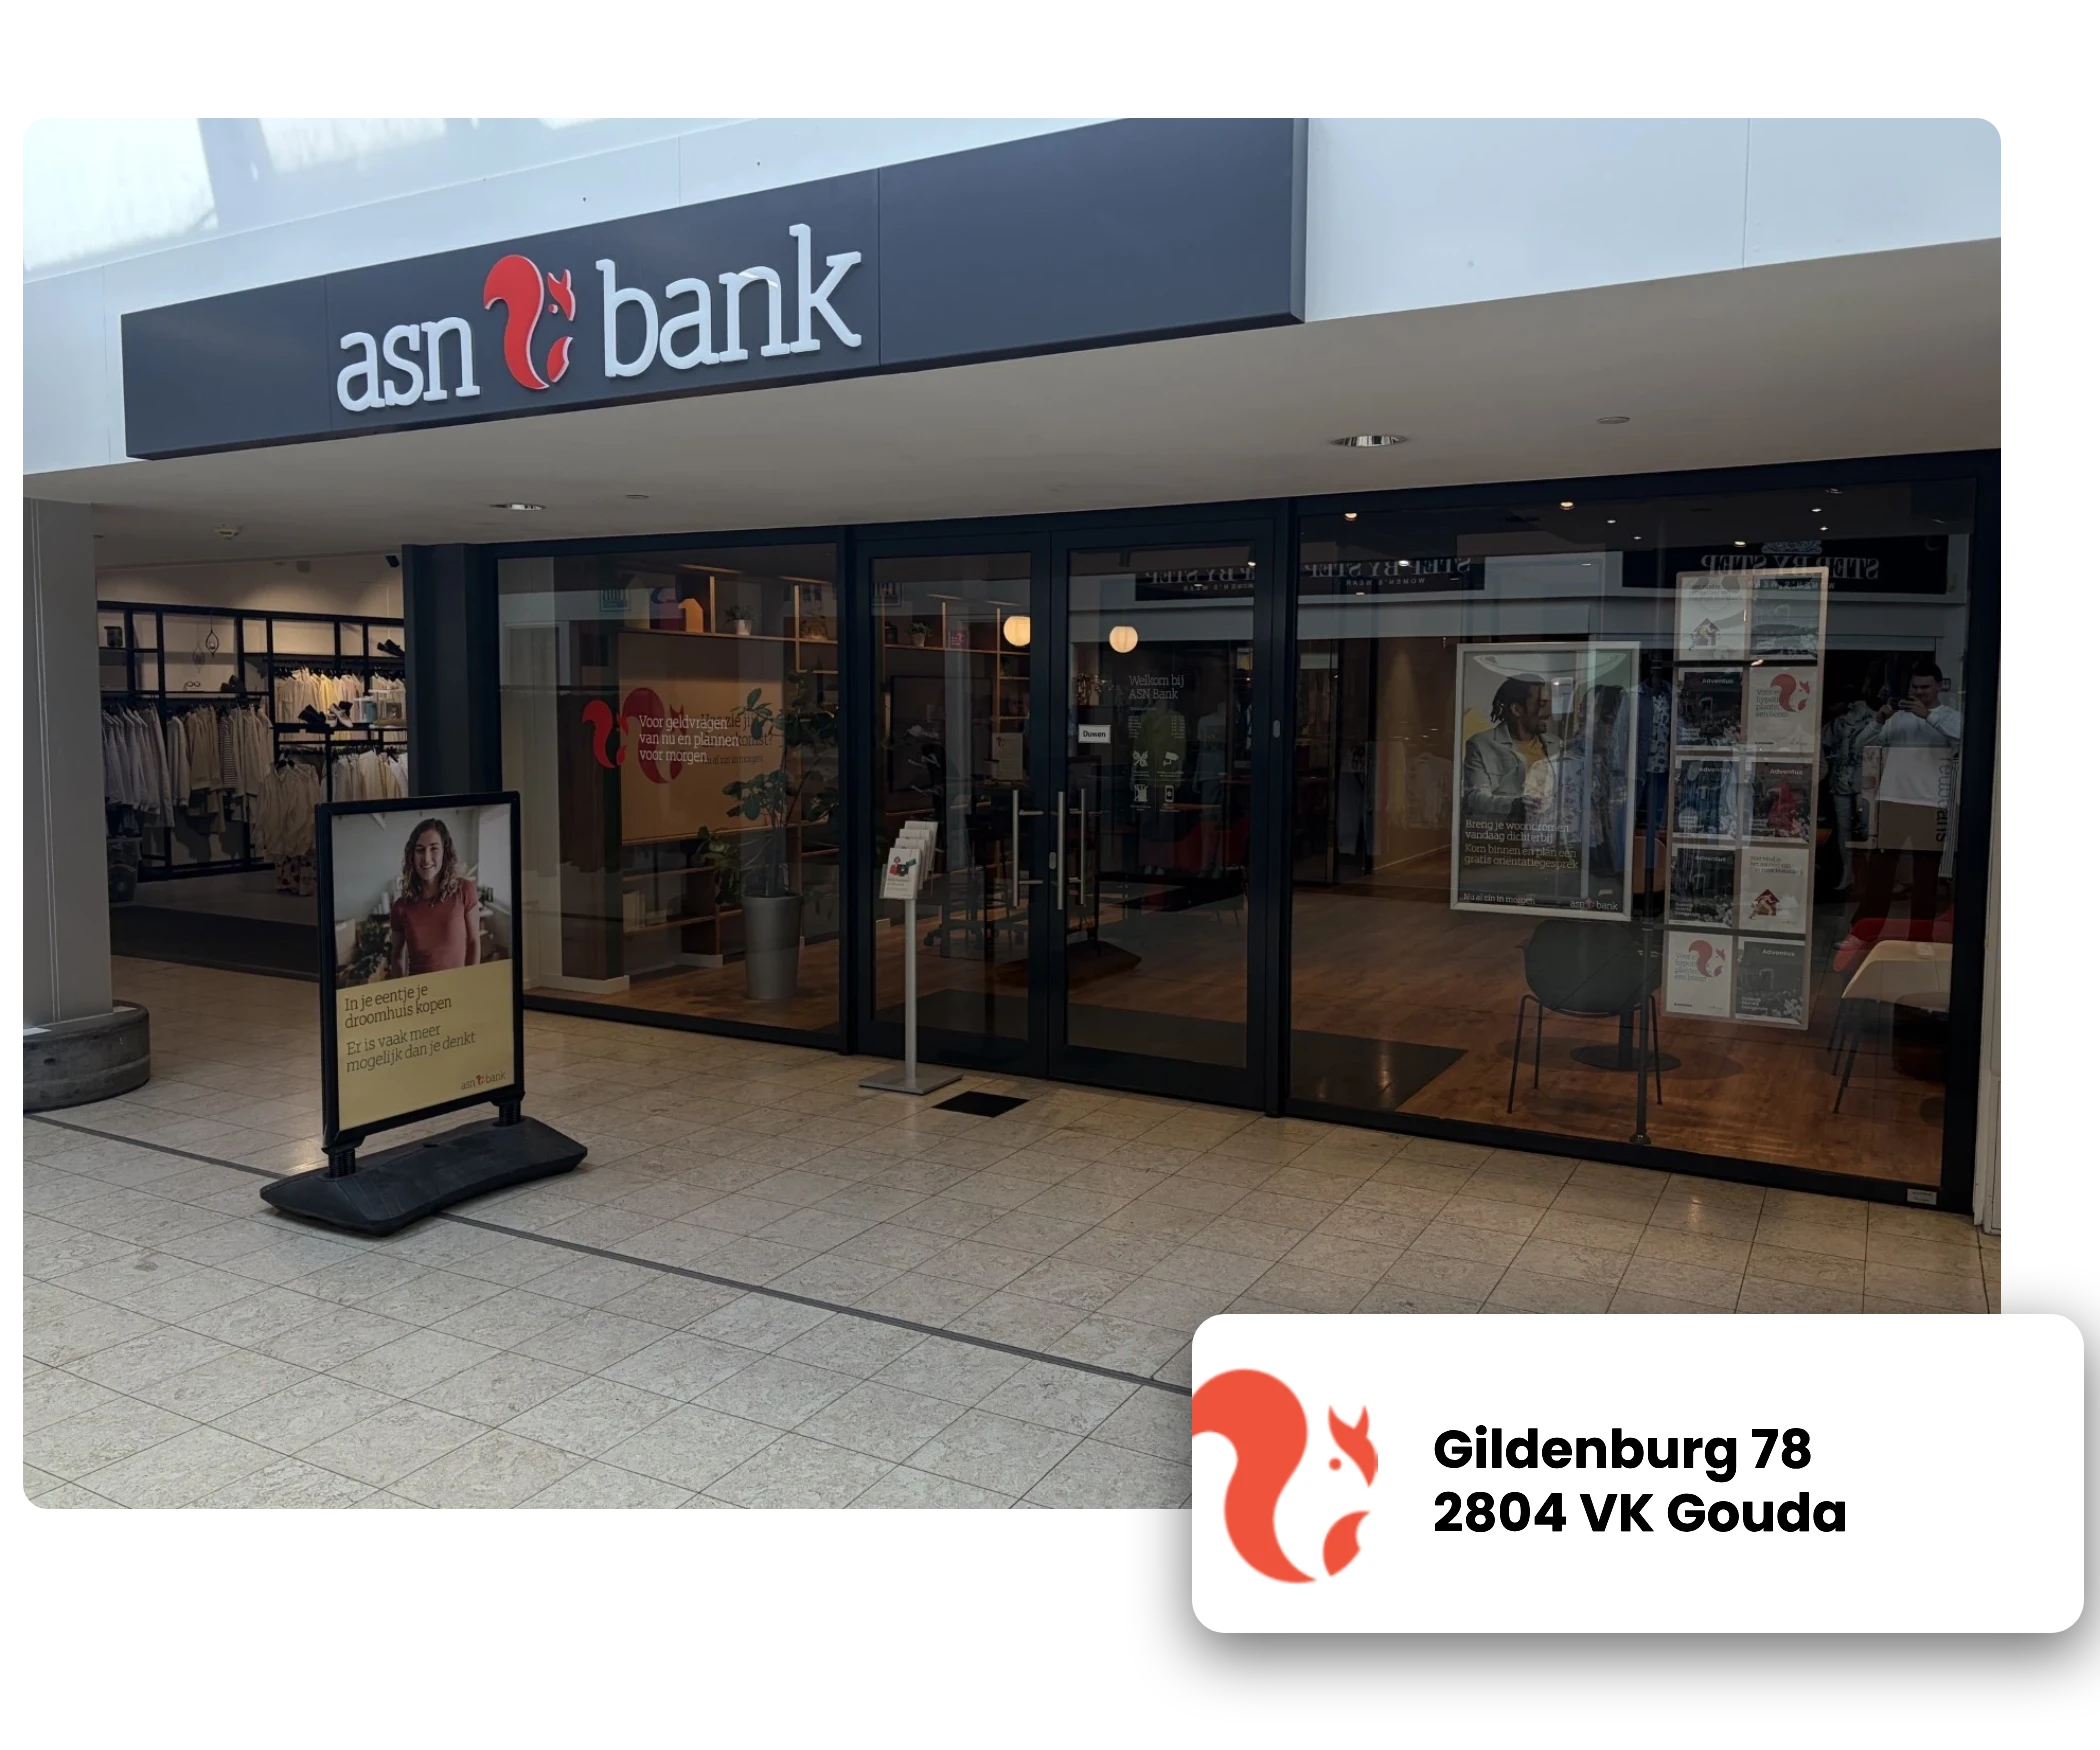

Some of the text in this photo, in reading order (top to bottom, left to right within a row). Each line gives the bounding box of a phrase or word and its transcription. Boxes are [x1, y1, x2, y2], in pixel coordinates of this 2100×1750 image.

[336, 223, 863, 413] asn bank
[1128, 674, 1184, 688] Welkom bij
[1128, 688, 1179, 700] ASN Bank
[639, 714, 663, 728] Voor
[666, 715, 728, 732] geldvragen
[639, 733, 659, 745] van
[662, 734, 675, 745] nu
[678, 734, 691, 745] en
[694, 732, 740, 748] plannen
[1083, 730, 1106, 738] Duwen
[639, 750, 707, 764] voor morgen
[1770, 768, 1803, 776] Adventus
[1465, 819, 1494, 832] Breng
[1495, 820, 1504, 831] je
[1465, 830, 1505, 843] vandaag
[1464, 844, 1487, 853] Kom
[1488, 844, 1520, 855] binnen
[1464, 855, 1492, 866] gratis
[1596, 900, 1619, 910] bank
[1762, 949, 1795, 957] Adventus
[345, 985, 428, 1012] In je eentje je
[345, 997, 452, 1029] droomhuis kopen
[346, 1024, 441, 1056] Er is vaak meer
[346, 1031, 477, 1073] mogelijk dan je denkt
[460, 1070, 506, 1090] asn bank
